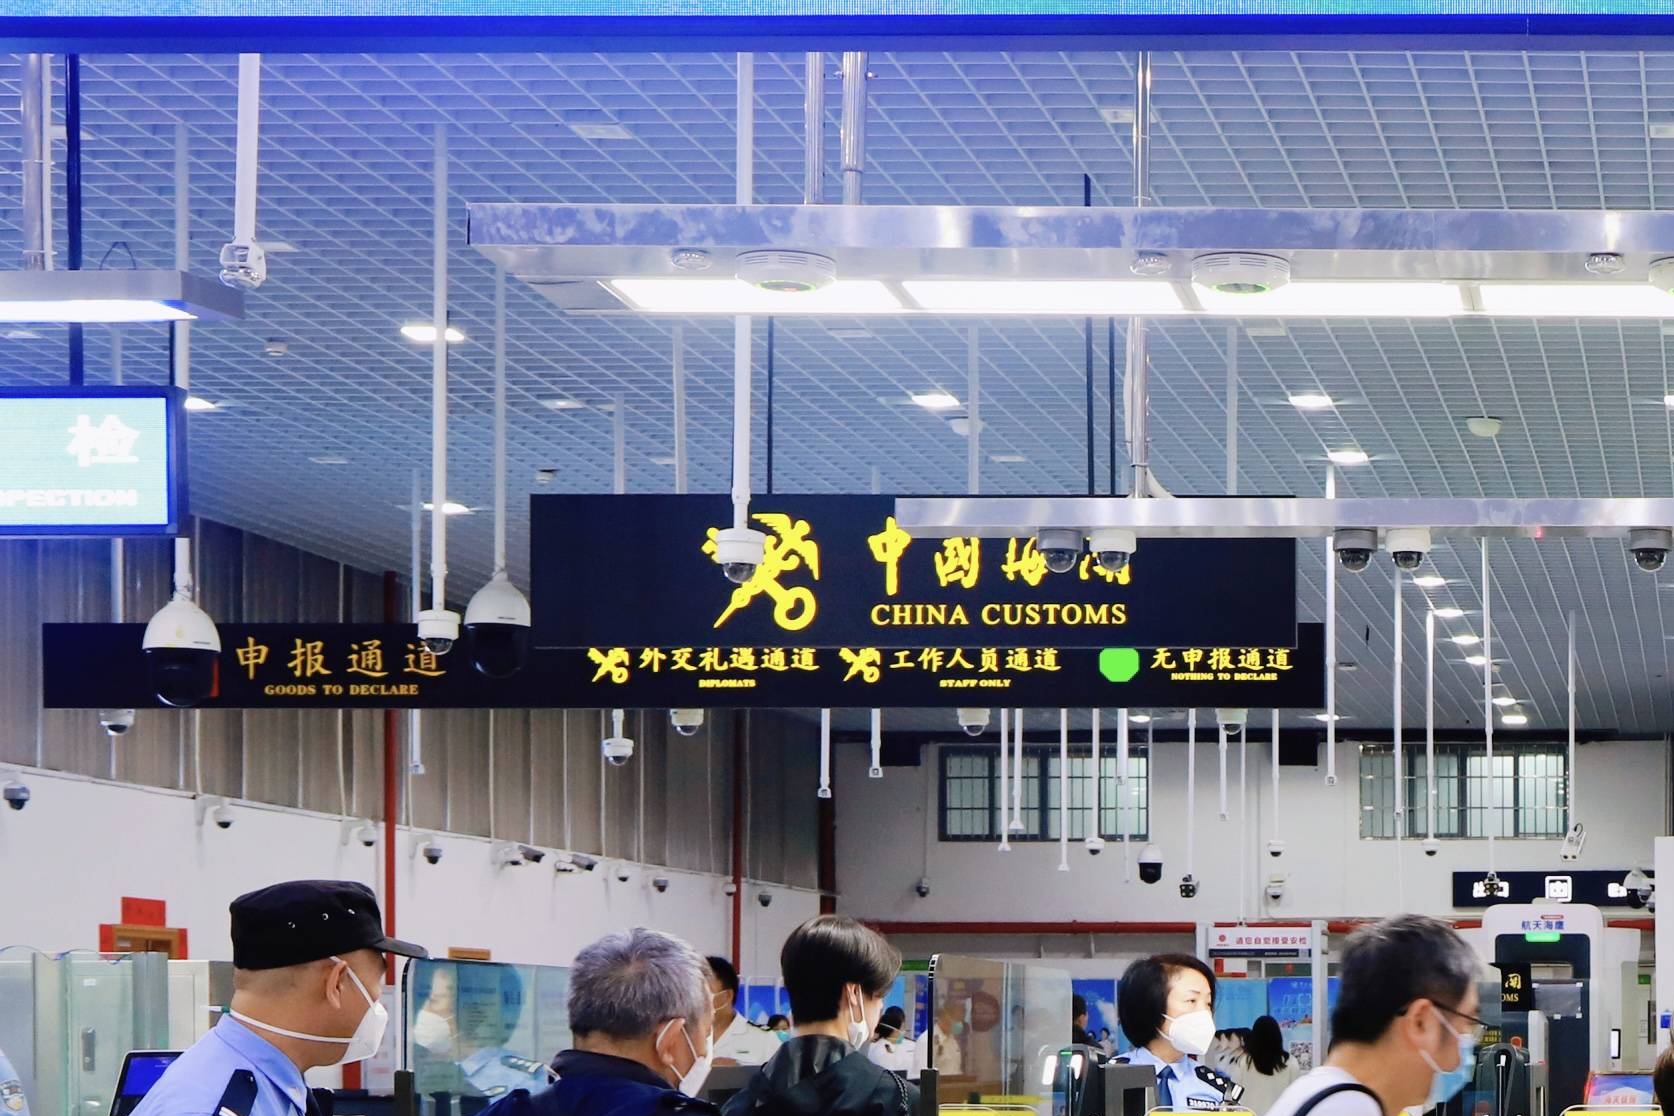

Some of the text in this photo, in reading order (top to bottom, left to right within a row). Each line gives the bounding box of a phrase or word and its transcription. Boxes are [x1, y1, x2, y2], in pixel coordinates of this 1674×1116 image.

[870, 604, 1127, 625] CHINA CUSTOMS
[235, 636, 447, 680] 申报通道
[638, 647, 820, 672] 外交礼遇通道
[889, 647, 1062, 672] 工作人员通道
[1150, 647, 1293, 672] 无申报通道
[940, 679, 1012, 688] STAFF ONLY
[1171, 672, 1278, 681] NOTHING TO DECLARE
[264, 684, 419, 696] GOODS TO DECLARE
